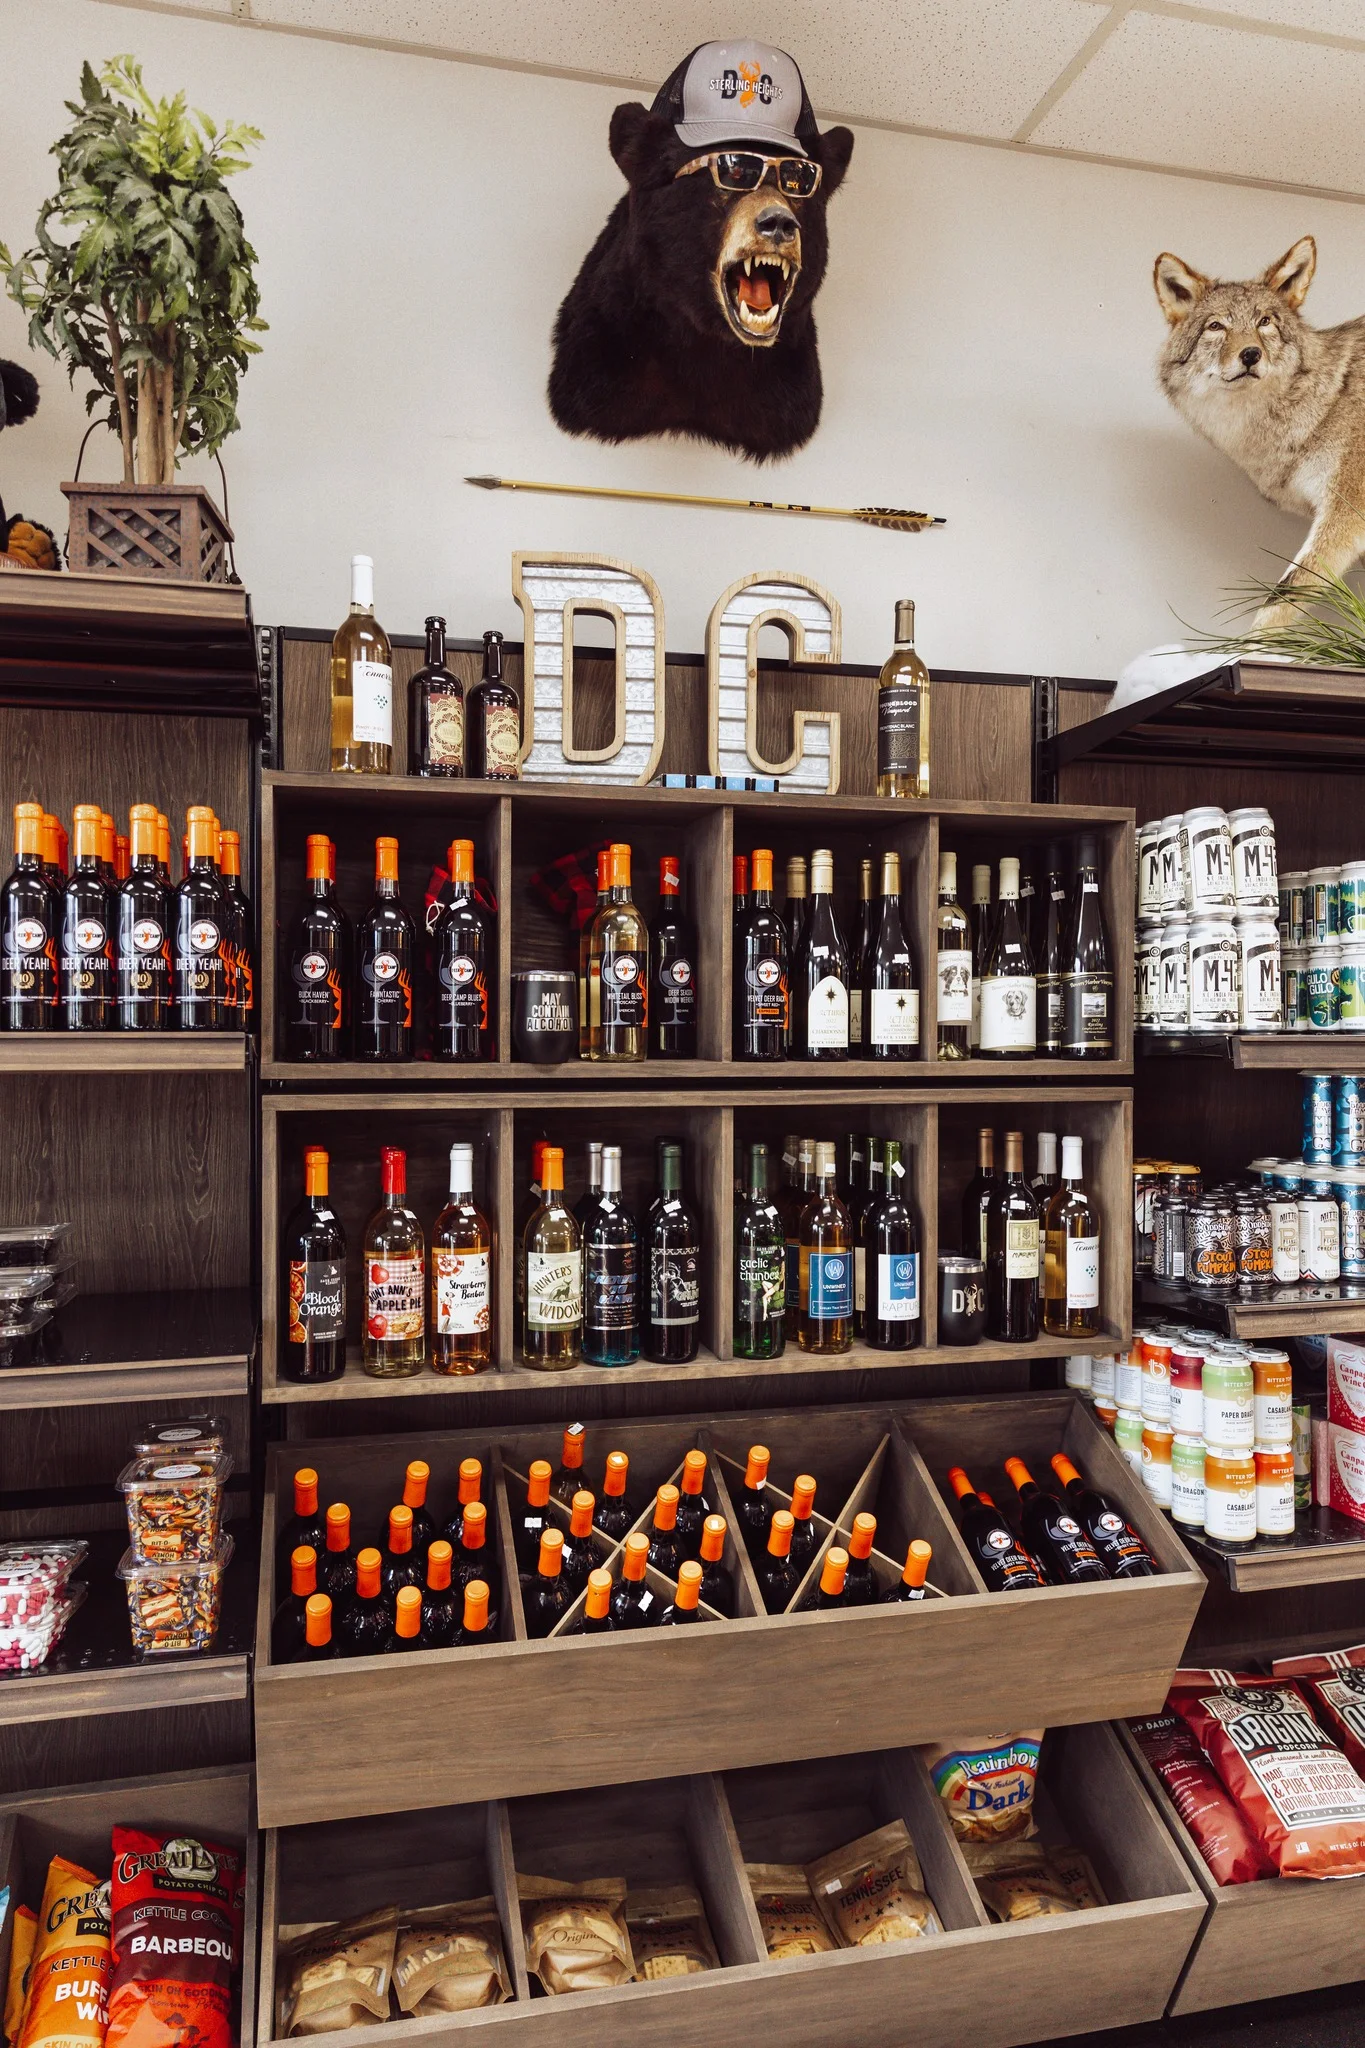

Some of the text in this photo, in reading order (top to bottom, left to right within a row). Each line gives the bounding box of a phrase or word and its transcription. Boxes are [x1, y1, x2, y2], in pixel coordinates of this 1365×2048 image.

[709, 78, 784, 100] STERLING HEIGHTS
[512, 551, 666, 788] D
[2, 957, 50, 970] DEER YEAH!
[62, 957, 109, 970] DEER YEAH!
[118, 957, 166, 971] DEER YEAH!
[176, 957, 223, 971] DEER YEAH!
[1307, 972, 1328, 985] GULO
[298, 990, 330, 998] BUCK HAVEN
[369, 990, 400, 998] FAWNTASTIC
[1309, 982, 1334, 995] GULO
[441, 993, 453, 1001] DEER
[541, 992, 561, 1006] MAY
[531, 1005, 570, 1018] CONTAIN
[527, 1017, 573, 1032] ALCOHOL
[1202, 1251, 1233, 1263] STOUT
[740, 1258, 769, 1271] gaelic
[1197, 1261, 1237, 1275] PUMPKIN
[533, 1265, 572, 1295] HUNTER'S
[740, 1270, 780, 1281] thunder
[449, 1279, 487, 1290] Strawberry
[305, 1290, 341, 1305] Blood
[368, 1284, 413, 1305] AUNT ANN'S
[461, 1288, 485, 1300] Bonbon
[951, 1288, 985, 1313] D C
[300, 1303, 342, 1317] Orange
[376, 1297, 422, 1312] APPLE PIE
[539, 1300, 581, 1320] WIDOW
[1342, 1373, 1362, 1388] Wine
[1221, 1411, 1240, 1419] PAPER
[1342, 1460, 1363, 1477] Wine
[1182, 1487, 1205, 1496] DRAGON
[1240, 1699, 1284, 1712] POPCORN
[1220, 1706, 1247, 1721] SNACKS
[1131, 1717, 1176, 1733] OP DADDY
[1277, 1743, 1319, 1752] POPCORN
[1255, 1751, 1303, 1768] Hand-seasoned
[1310, 1750, 1327, 1758] small
[1262, 1767, 1286, 1784] MADE
[1300, 1763, 1320, 1776] RUBY
[1317, 1763, 1334, 1774] RED
[1270, 1773, 1356, 1800] & PURE AVOCADO
[966, 1779, 1032, 1811] Dark
[1278, 1790, 1358, 1814] NOTHING ARTIFICIAL
[1292, 1811, 1317, 1819] MADE
[118, 1850, 192, 1884] GREAT
[158, 1879, 217, 1892] POTATO CHIP
[839, 1865, 905, 1909] TENNESSEE
[46, 1889, 112, 1934] GREA
[133, 1904, 188, 1923] KETTLE
[83, 1921, 110, 1932] POTA
[130, 1935, 234, 1962] BARBEQU
[50, 1955, 107, 1974] KETTLE
[55, 1979, 108, 2002] BUFF
[137, 1984, 181, 1996] SKIN ON
